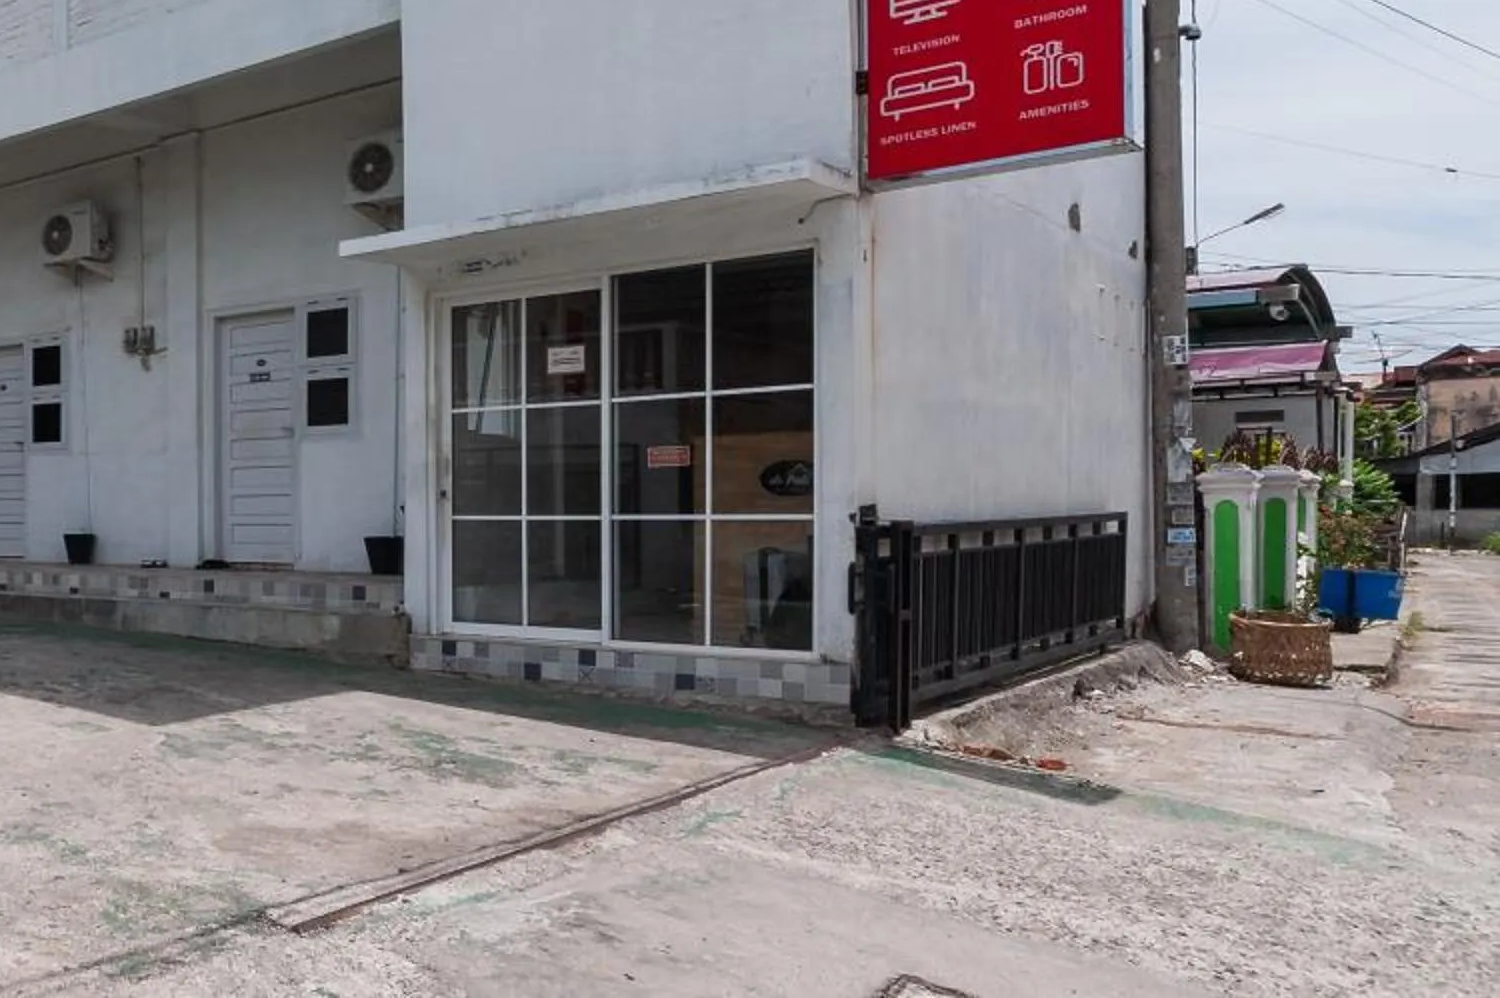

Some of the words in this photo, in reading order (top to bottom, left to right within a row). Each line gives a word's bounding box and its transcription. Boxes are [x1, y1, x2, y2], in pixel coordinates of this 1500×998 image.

[1014, 4, 1088, 29] BATHROOM
[892, 33, 960, 57] TELEVISION
[1019, 99, 1090, 121] AMENITIES
[880, 127, 939, 146] SPOTLESS
[941, 121, 977, 135] LINEN
